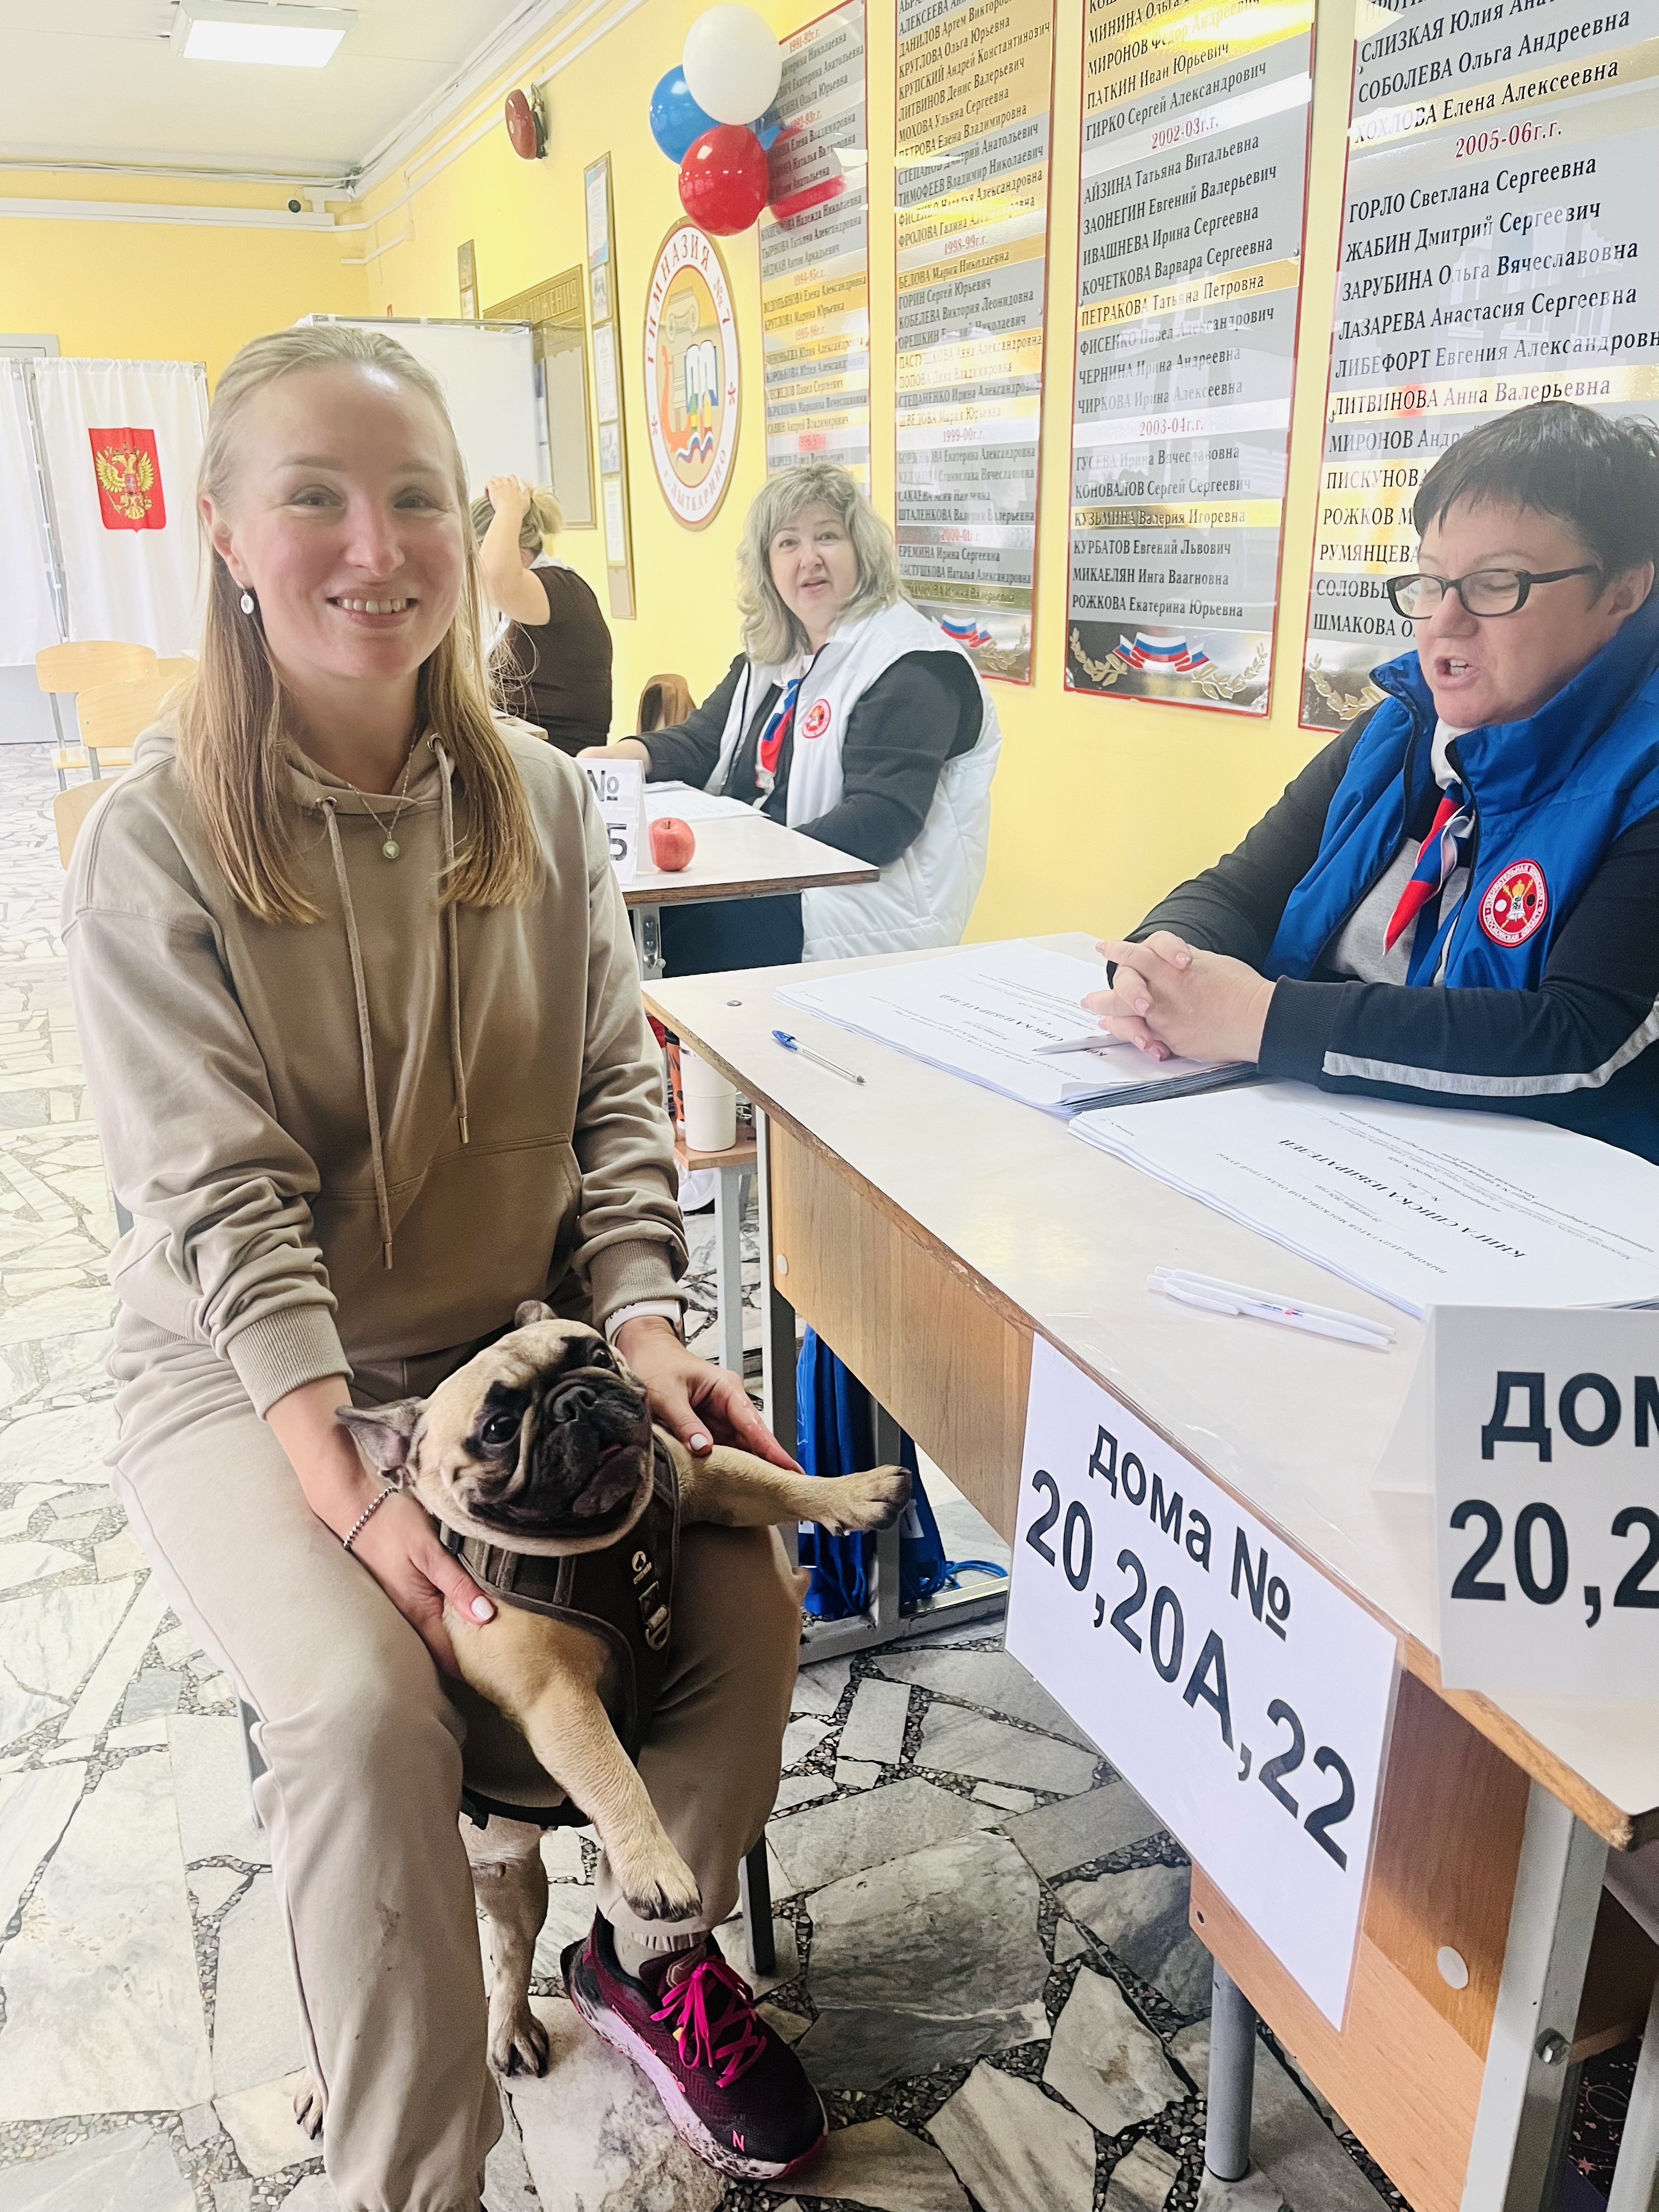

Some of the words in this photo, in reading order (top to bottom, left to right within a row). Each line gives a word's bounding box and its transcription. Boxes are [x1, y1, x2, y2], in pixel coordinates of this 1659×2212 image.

[899, 24, 940, 59] ДАНИЛОВ
[942, 15, 966, 37] Артем
[899, 45, 943, 79] КРУГЛОВА
[945, 37, 968, 57] Ольга
[971, 16, 1009, 44] Юрьевна
[1088, 5, 1142, 47] МИНИНА
[1361, 17, 1444, 63] СЛИЗКАЯ
[1449, 3, 1504, 34] Юлия
[899, 64, 944, 100] КРУПСКИЙ
[946, 52, 975, 78] Андрей
[978, 21, 1049, 64] Константинович
[1087, 36, 1148, 78] МИРОНОВ
[1087, 74, 1136, 110] ПАТКИН
[1139, 66, 1169, 88] Иван
[1173, 41, 1228, 75] Юрьевич
[1358, 57, 1454, 103] СОБОЛЕВА
[1457, 45, 1512, 75] Ольга
[1517, 12, 1630, 58] Андреевна
[899, 88, 945, 122] ЛИТВИНОВ
[947, 82, 971, 103] Денис
[974, 58, 1024, 89] Валерьевич
[1086, 112, 1124, 142] ГИРКО
[1128, 95, 1166, 126] Сергей
[1170, 62, 1266, 110] Александрович
[1355, 103, 1438, 143] ХОХЛОВА
[1442, 93, 1496, 120] Елена
[1501, 61, 1620, 105] Алексеевна
[899, 116, 933, 143] МОХОВА
[935, 108, 963, 128] Ульяна
[966, 88, 1008, 115] Сергеевна
[938, 131, 961, 148] Елена
[964, 105, 1026, 138] Владимировна
[1454, 121, 1561, 159] 2005-06г.г.
[1084, 170, 1132, 204] АЙЗИНА
[1135, 162, 1181, 187] Татьяна
[1185, 136, 1259, 171] Витальевна
[1349, 193, 1406, 222] ГОРЛО
[1409, 180, 1489, 210] Светлана
[1495, 157, 1598, 193] Сергеевна
[1084, 201, 1145, 235] ЗАОНЕГИН
[1149, 185, 1197, 215] Евгений
[1200, 166, 1276, 200] Валерьевич
[1083, 233, 1149, 266] ИВАШНЕВА
[1152, 226, 1189, 249] Ирина
[1194, 207, 1259, 236] Сергеевна
[1345, 232, 1411, 262] ЖАБИН
[1415, 215, 1493, 248] Дмитрий
[1499, 201, 1602, 235] Сергеевич
[1082, 264, 1151, 296] КОЧЕТКОВА
[1154, 256, 1202, 279] Варвара
[1206, 238, 1272, 266] Сергеевна
[1342, 268, 1434, 301] ЗАРУБИНА
[1438, 264, 1490, 285] Ольга
[1496, 241, 1640, 278] Вячеславовна
[647, 234, 709, 364] ГИМНАЗИЯ
[1081, 297, 1148, 326] ПЕТРАКОВА
[1153, 290, 1198, 311] Татьяна
[1203, 276, 1263, 300] Петровна
[1338, 309, 1427, 340] ЛАЗАРЕВА
[1430, 302, 1525, 326] Анастасия
[1531, 287, 1638, 317] Сергеевна
[1080, 330, 1136, 356] ФИСЕНКО
[1141, 328, 1173, 345] Павел
[1177, 309, 1274, 337] Александрович
[1079, 362, 1132, 386] ЧЕРНИНА
[1137, 360, 1171, 379] Ирина
[1176, 349, 1240, 370] Андреевна
[1335, 349, 1430, 378] ЛИБЕФОРТ
[1435, 347, 1508, 366] Евгения
[1078, 393, 1130, 414] ЧИРКОВА
[1134, 391, 1169, 409] Ирина
[1173, 382, 1243, 402] Алексеевна
[1332, 388, 1439, 415] ЛИТВИНОВА
[1443, 387, 1488, 406] Анна
[1494, 380, 1611, 402] Валерьевна
[1329, 430, 1414, 453] МИРОНОВ
[1417, 425, 1480, 448] Андр
[1075, 481, 1144, 499] КОНОВАЛОВ
[1147, 478, 1185, 498] Сергей
[1189, 478, 1251, 496] Сергеевич
[1327, 467, 1426, 489] ПИСКУНОВ
[1138, 510, 1185, 528] Валерия
[1189, 509, 1245, 527] Игоревна
[1323, 507, 1394, 525] РОЖКОВ
[1074, 540, 1130, 554] КУРБАТОВ
[1133, 539, 1177, 554] Евгений
[1181, 540, 1231, 554] Львович
[1073, 567, 1135, 582] МИКАЕЛЯН
[1138, 568, 1164, 583] Инга
[1168, 569, 1228, 585] Ваагновна
[1072, 595, 1126, 611] РОЖКОВА
[1129, 596, 1185, 615] Екатерина
[1189, 599, 1243, 618] Юрьевна
[1313, 613, 1397, 636] ШМАКОВА
[1278, 1139, 1387, 1192] ИЗБИРАТЕЛЕЙ
[1387, 1192, 1459, 1227] СПИСКА
[1461, 1227, 1528, 1258] КНИГА
[1088, 1424, 1210, 1573] дома
[1230, 1526, 1291, 1641] №
[1025, 1469, 1356, 1872] 20,20А,22
